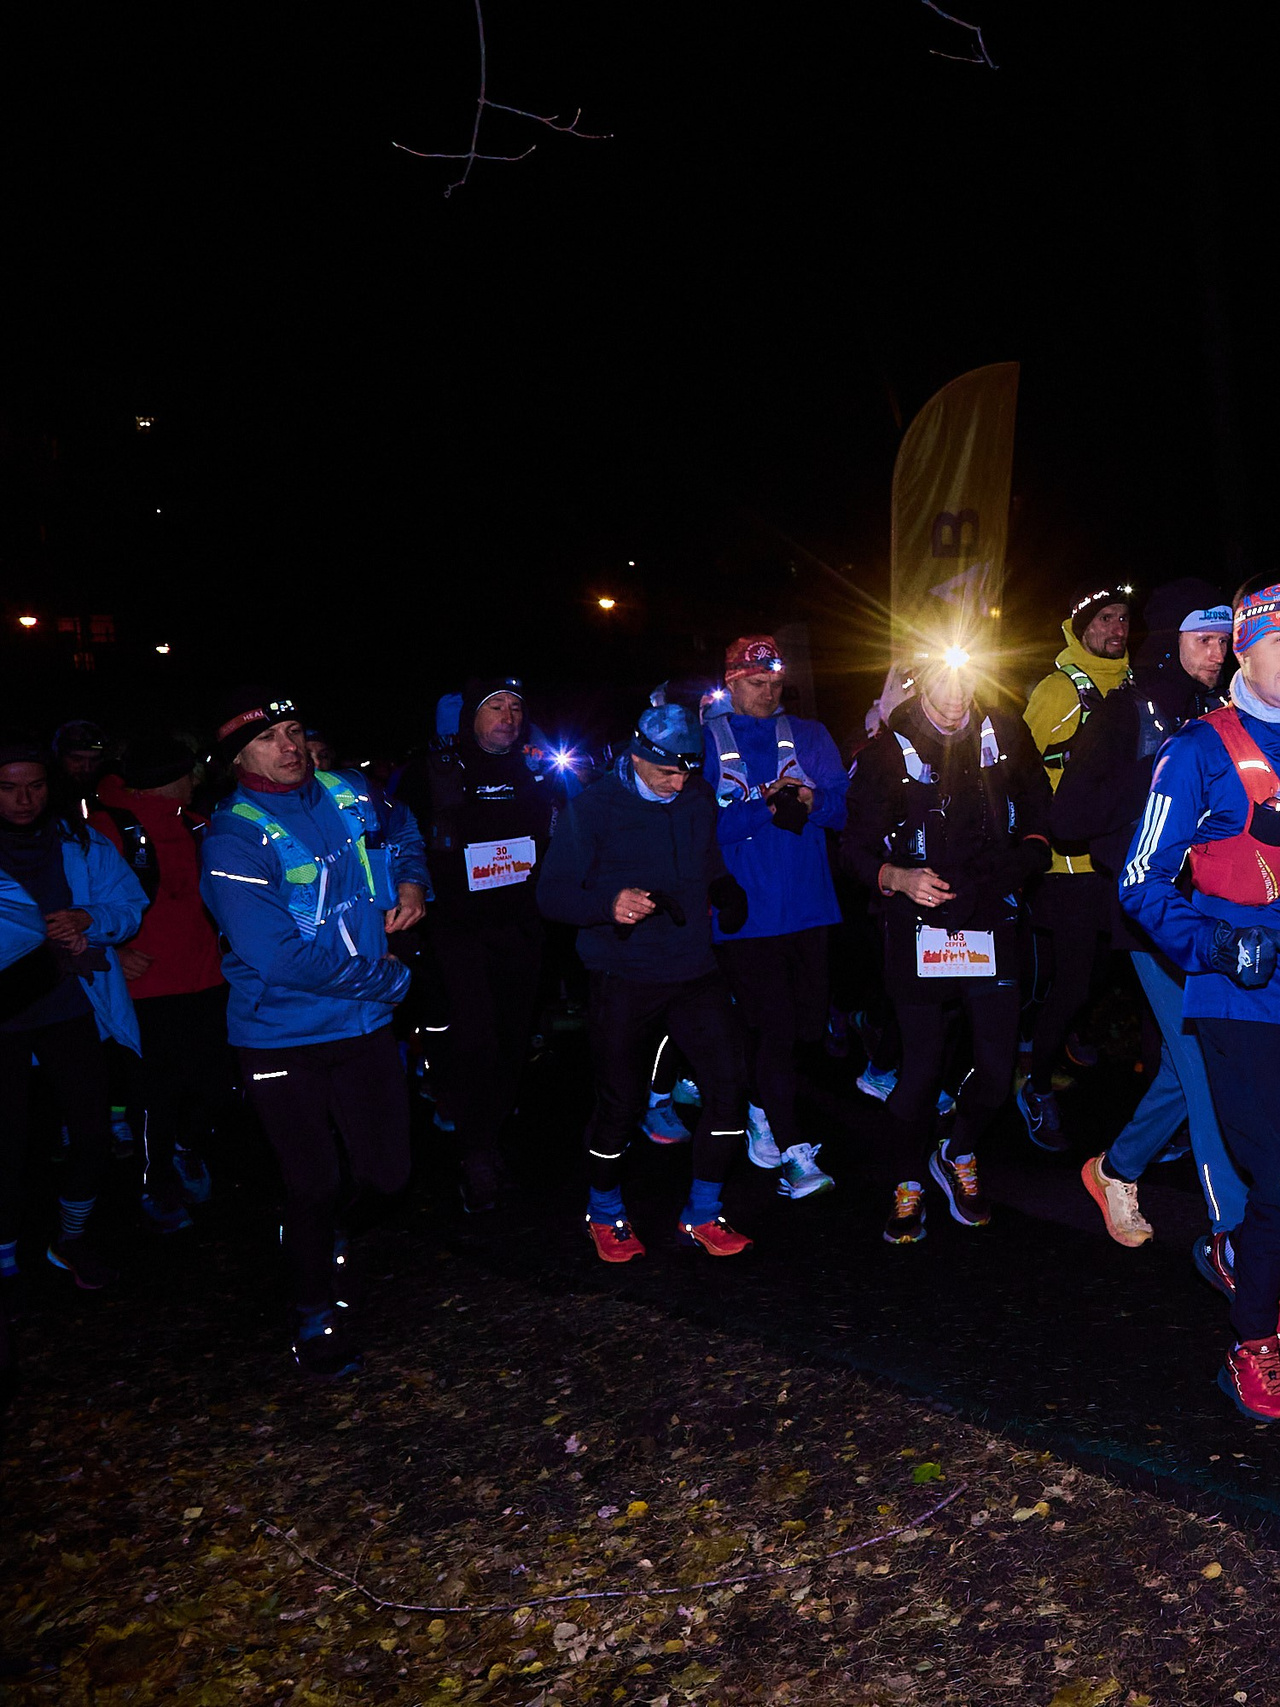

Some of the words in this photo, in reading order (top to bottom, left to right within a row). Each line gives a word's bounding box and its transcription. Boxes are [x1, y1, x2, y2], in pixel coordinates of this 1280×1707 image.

[496, 846, 507, 856] 30
[492, 854, 513, 862] РОМАН
[947, 932, 965, 942] 103
